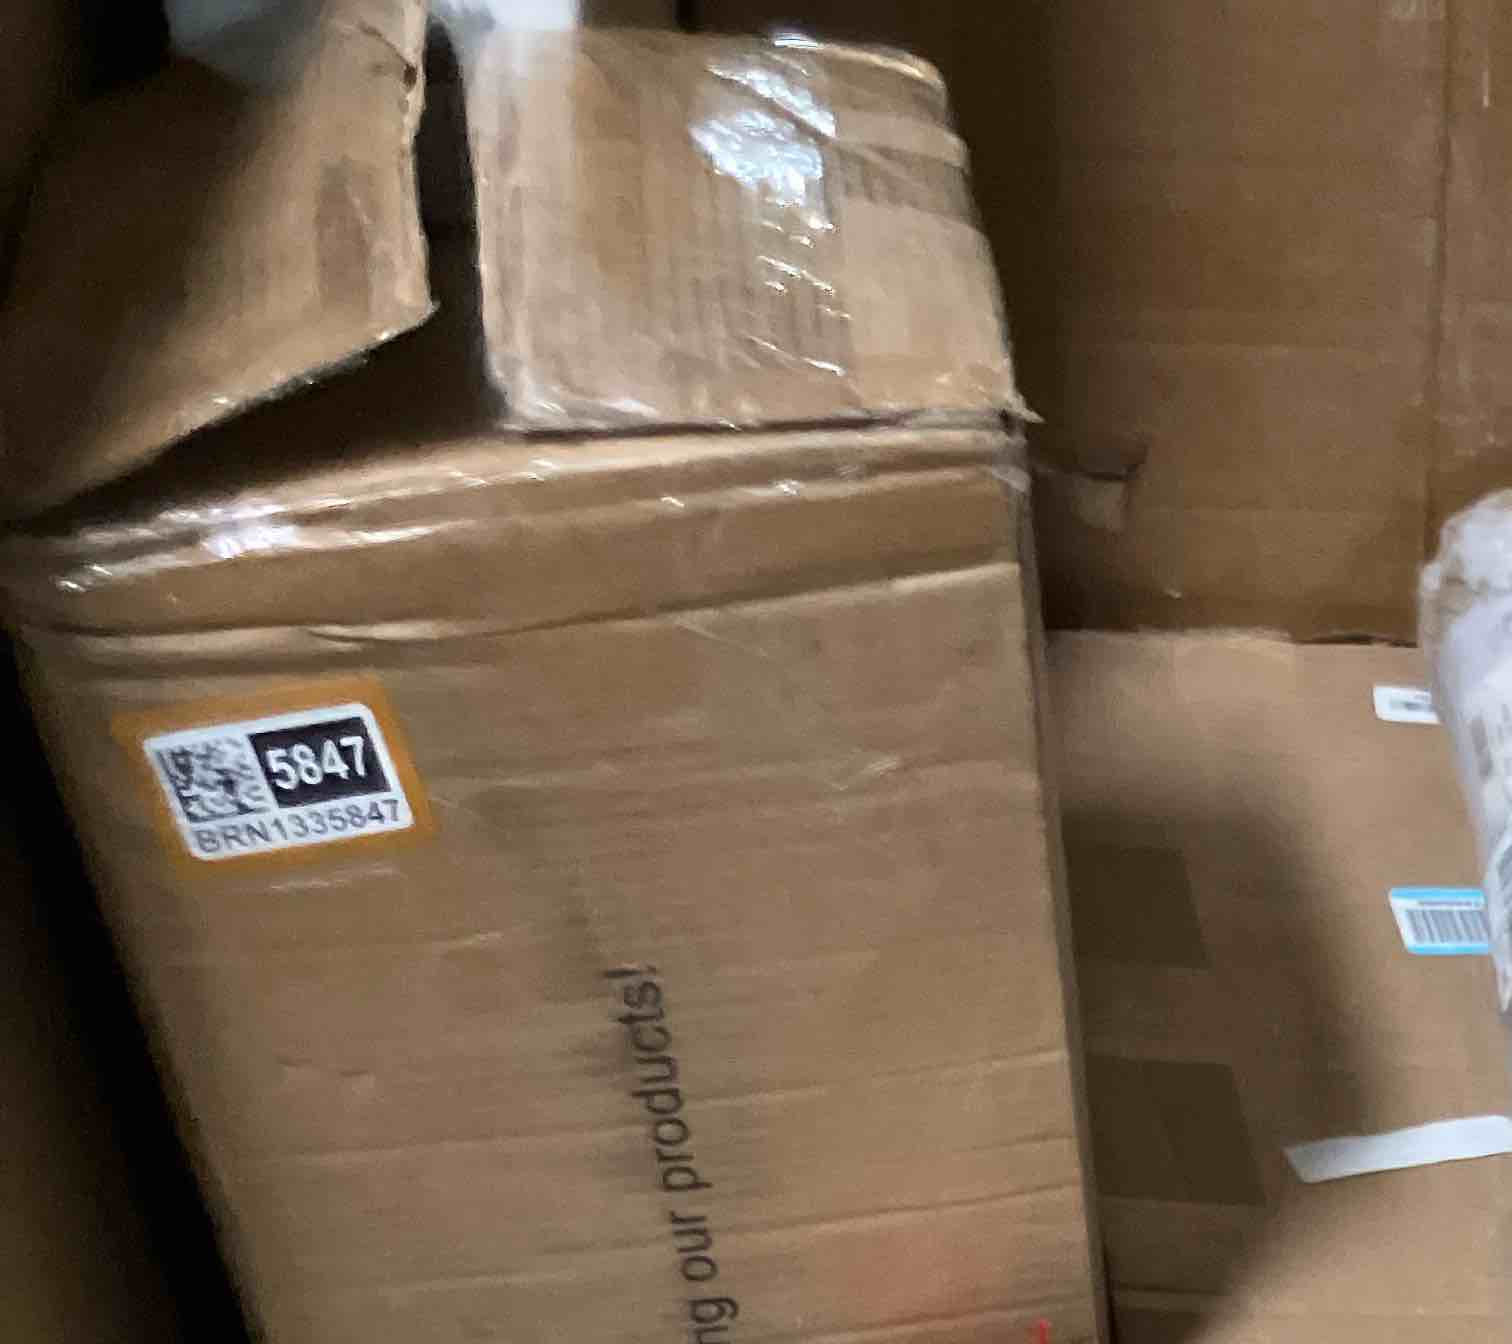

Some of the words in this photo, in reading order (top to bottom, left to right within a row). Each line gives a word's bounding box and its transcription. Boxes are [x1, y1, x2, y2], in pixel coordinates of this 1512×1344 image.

[267, 734, 370, 791] 5847
[195, 800, 401, 854] BRN1335847
[605, 964, 713, 1193] products!
[669, 1210, 719, 1283] our
